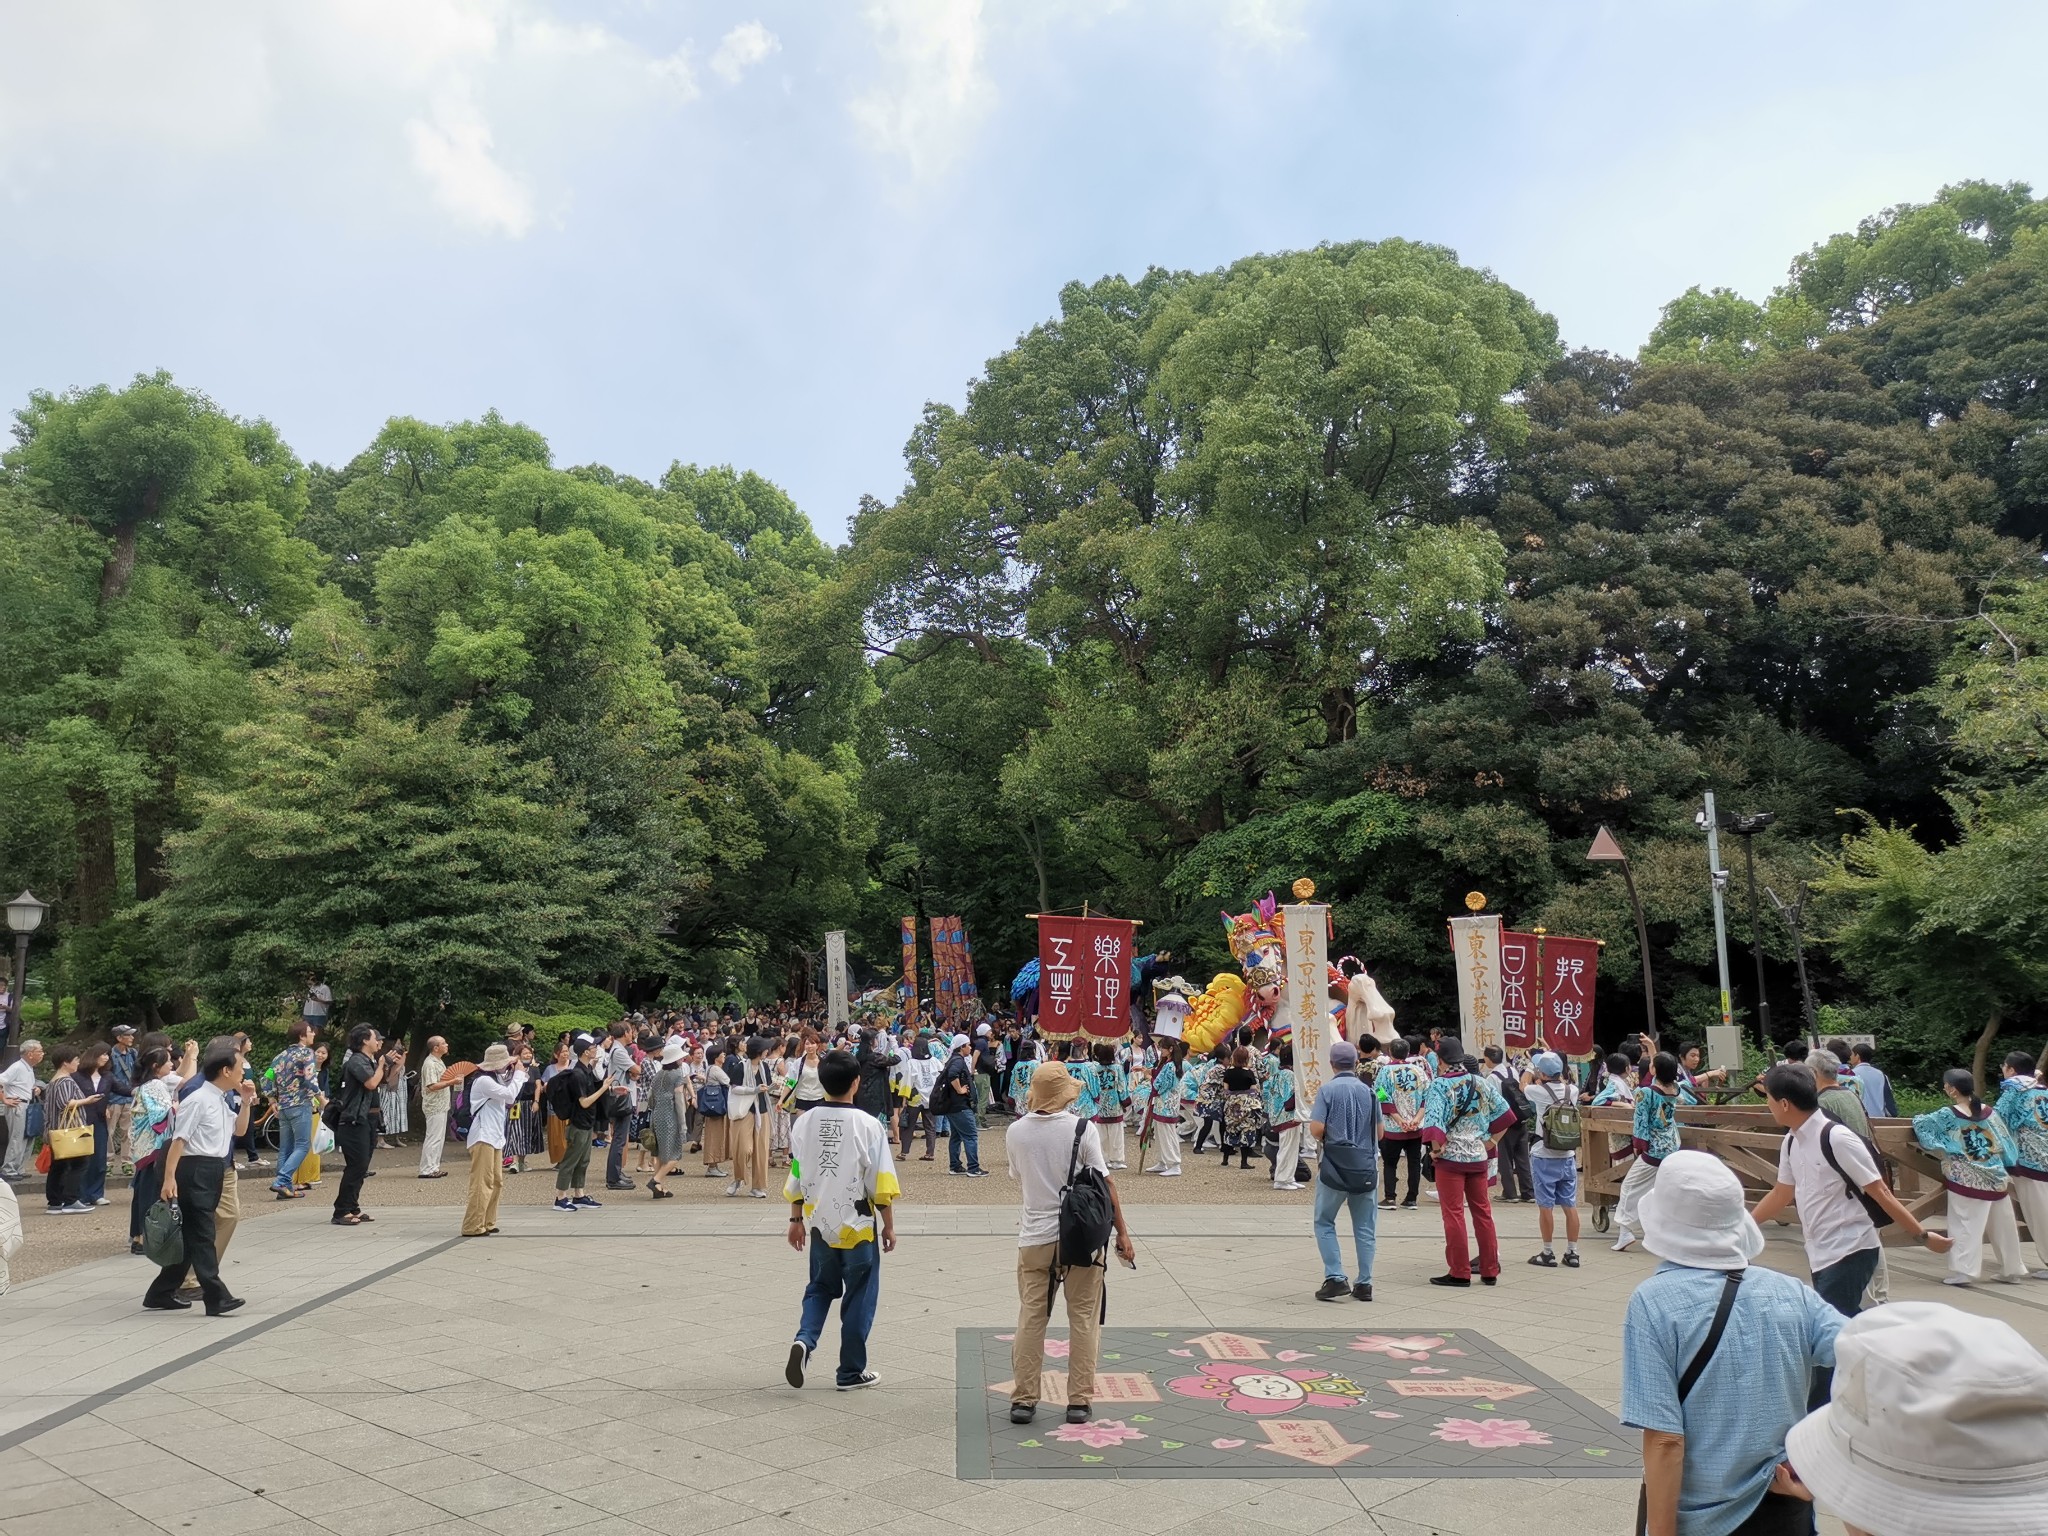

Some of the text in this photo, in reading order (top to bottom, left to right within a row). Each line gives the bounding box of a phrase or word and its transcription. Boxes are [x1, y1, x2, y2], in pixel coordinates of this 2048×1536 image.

[1466, 929, 1496, 1071] 東京藝術
[819, 1118, 844, 1177] 藝祭
